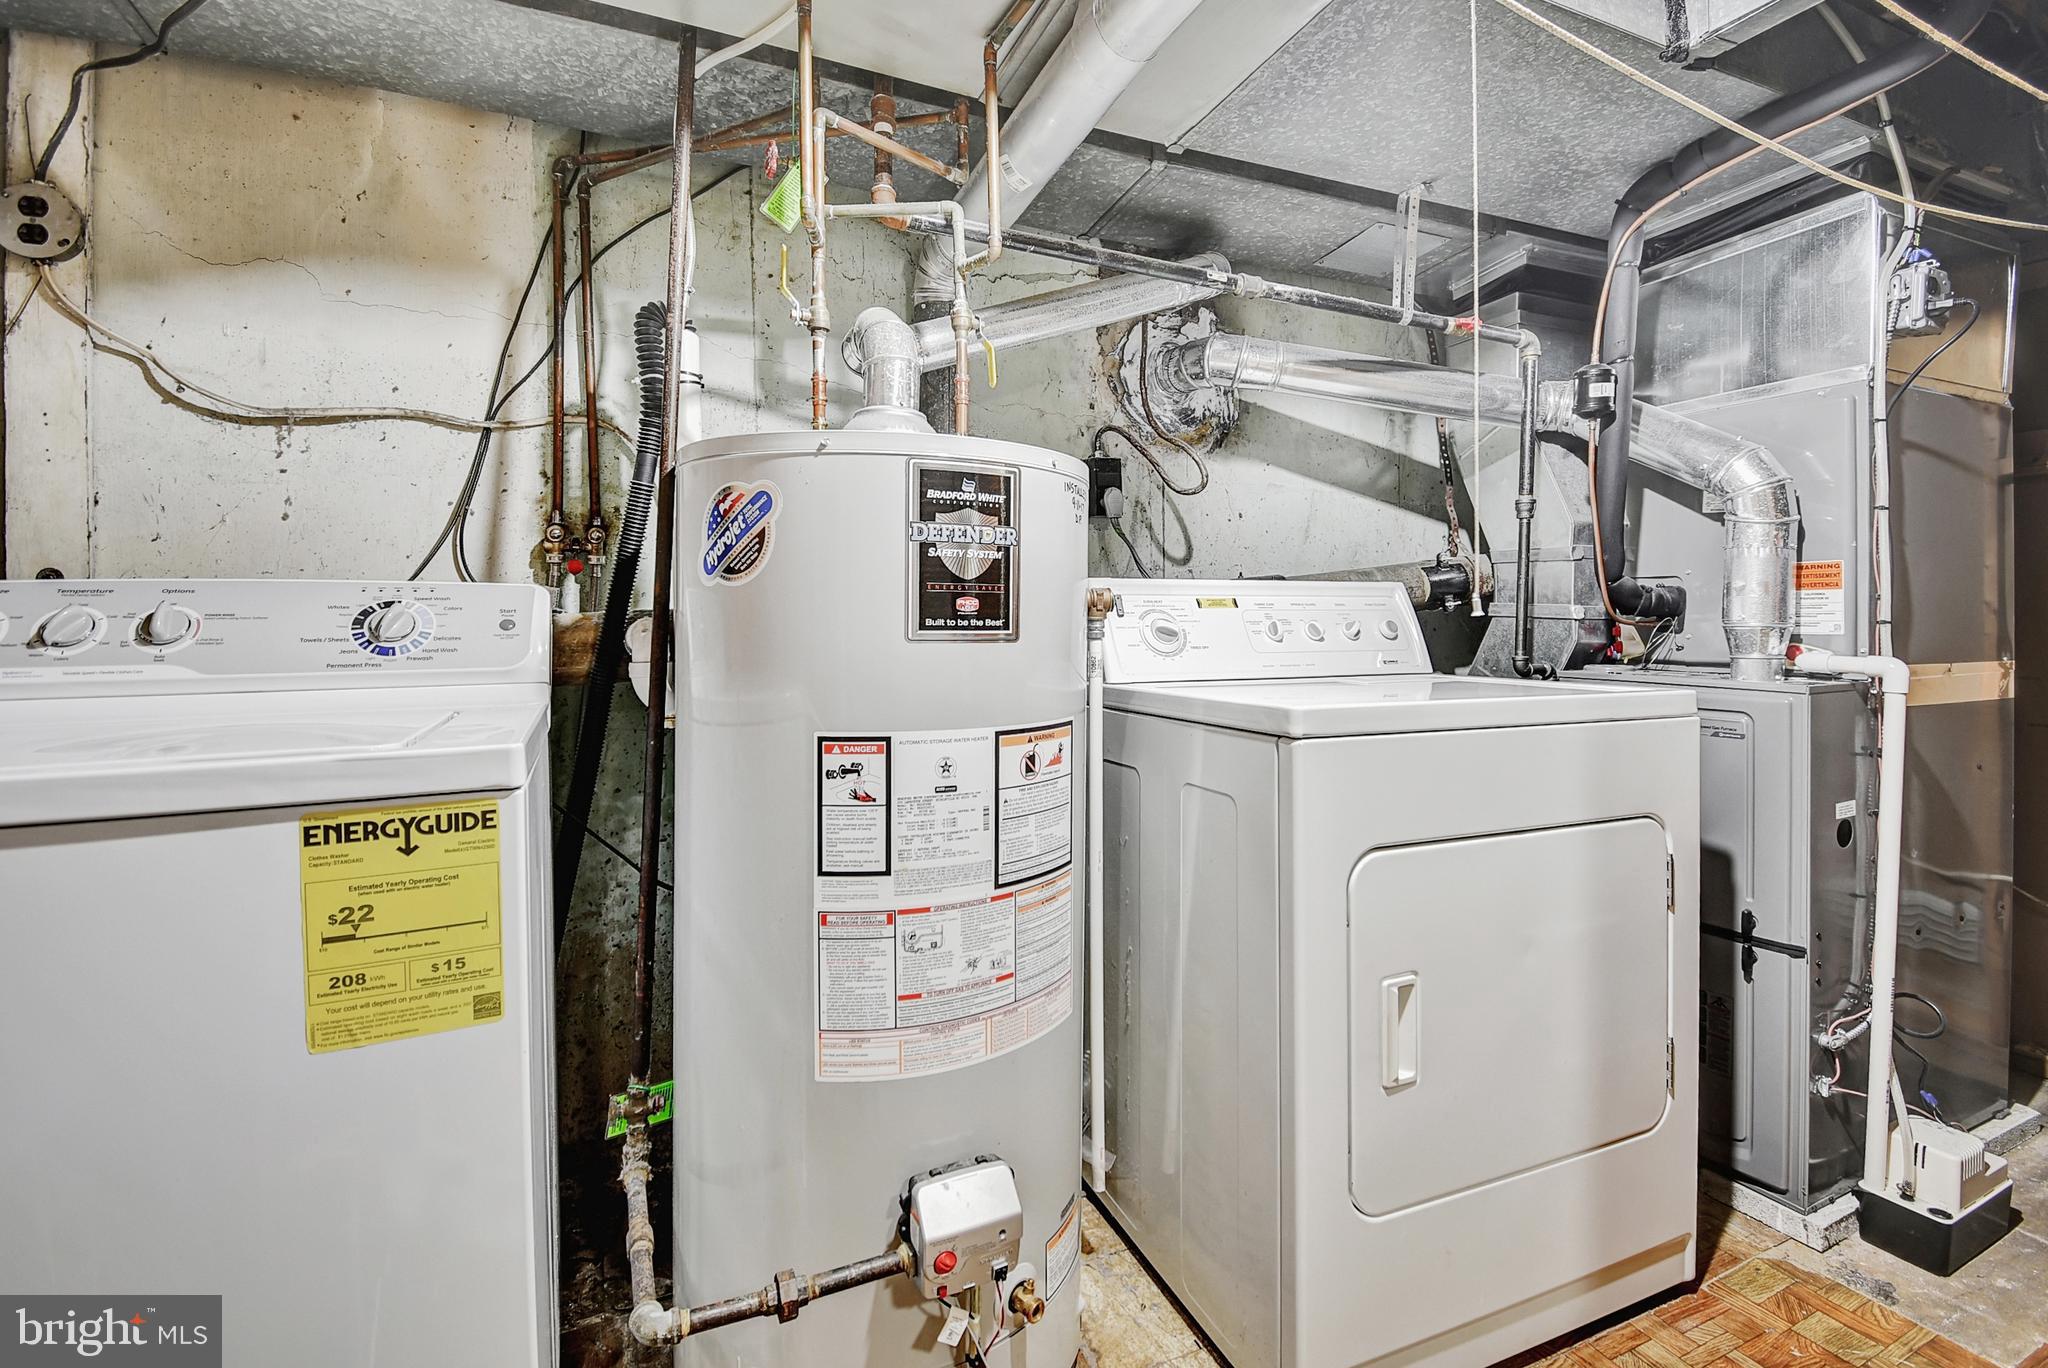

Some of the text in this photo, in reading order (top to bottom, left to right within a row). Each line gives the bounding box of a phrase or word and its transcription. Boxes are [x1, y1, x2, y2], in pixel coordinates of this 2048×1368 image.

[926, 489, 1006, 503] BRADFORD WHITE
[932, 499, 999, 508] CORPORATION
[705, 512, 747, 569] Hydrojet
[910, 521, 1018, 546] DEFENDER
[928, 547, 1004, 560] SAFETY SYSTEM
[925, 618, 1005, 627] Built to be the Best
[1034, 732, 1056, 741] WARNING
[843, 745, 878, 753] DANGER
[303, 809, 497, 856] ENERGYGUIDE
[333, 857, 364, 866] STANDARD
[348, 873, 460, 893] Estimated Yearly Operating Cost
[328, 904, 375, 926] $22
[328, 972, 367, 990] 208
[416, 976, 440, 984] Estimated
[441, 974, 455, 982] Yearly
[455, 969, 482, 979] Operating
[316, 990, 342, 999] Estimated
[343, 988, 359, 997] Yearly
[360, 984, 387, 994] Electricity
[325, 1006, 342, 1015] Your
[343, 1005, 358, 1013] cost
[358, 1001, 371, 1010] will
[371, 998, 397, 1010] depend
[408, 995, 424, 1005] your
[424, 991, 442, 1003] utility
[442, 989, 459, 999] rates
[460, 986, 473, 994] and
[473, 984, 486, 992] use.
